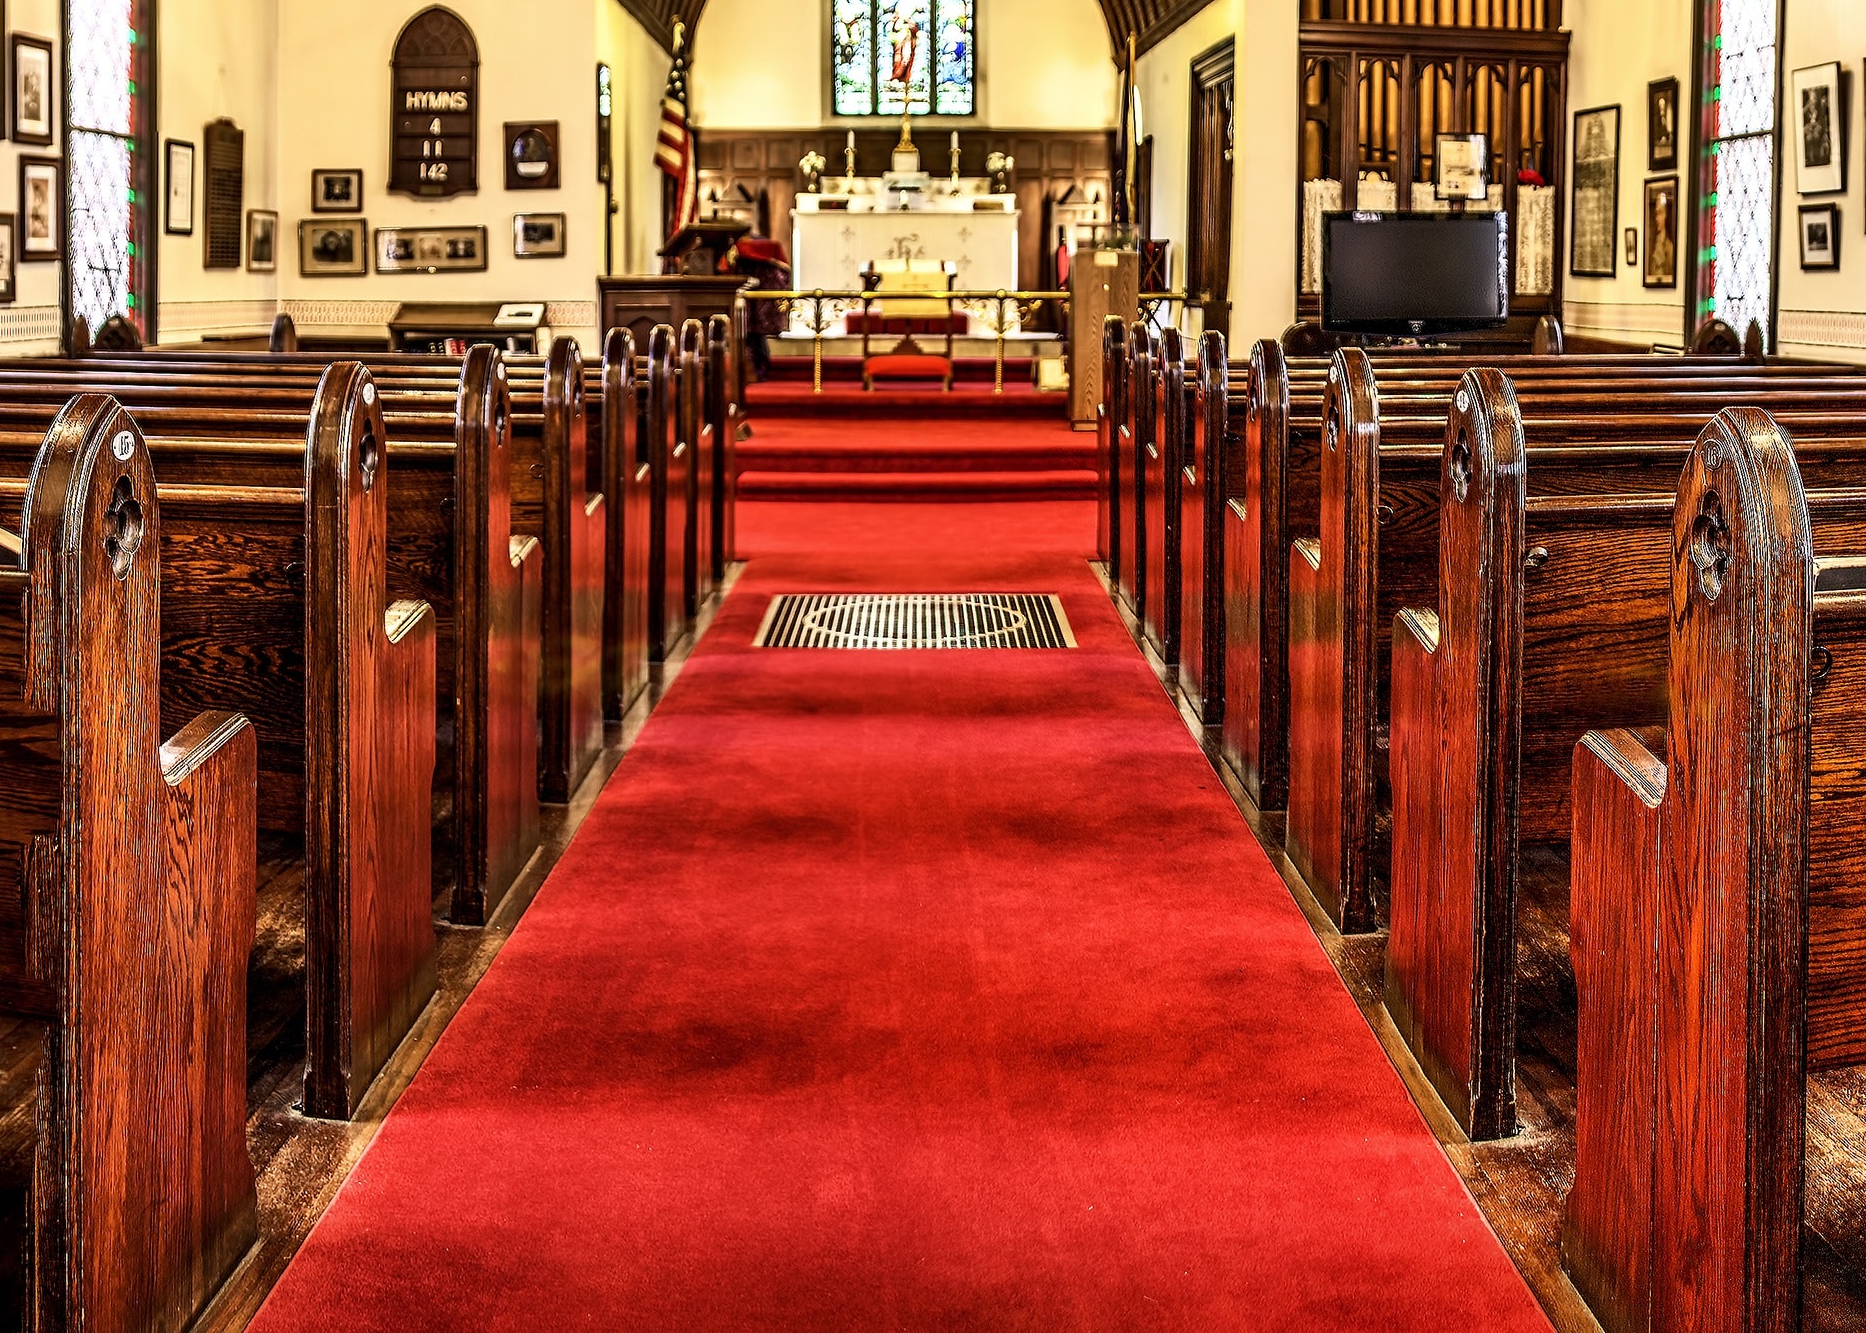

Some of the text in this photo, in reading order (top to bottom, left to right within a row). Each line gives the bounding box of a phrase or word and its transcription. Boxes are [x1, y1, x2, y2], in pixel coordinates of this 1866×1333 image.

[405, 91, 468, 111] HYMNS
[429, 117, 441, 136] 4
[423, 140, 442, 158] 11
[420, 162, 449, 182] 142
[119, 435, 130, 456] 15
[1706, 444, 1720, 467] 16
